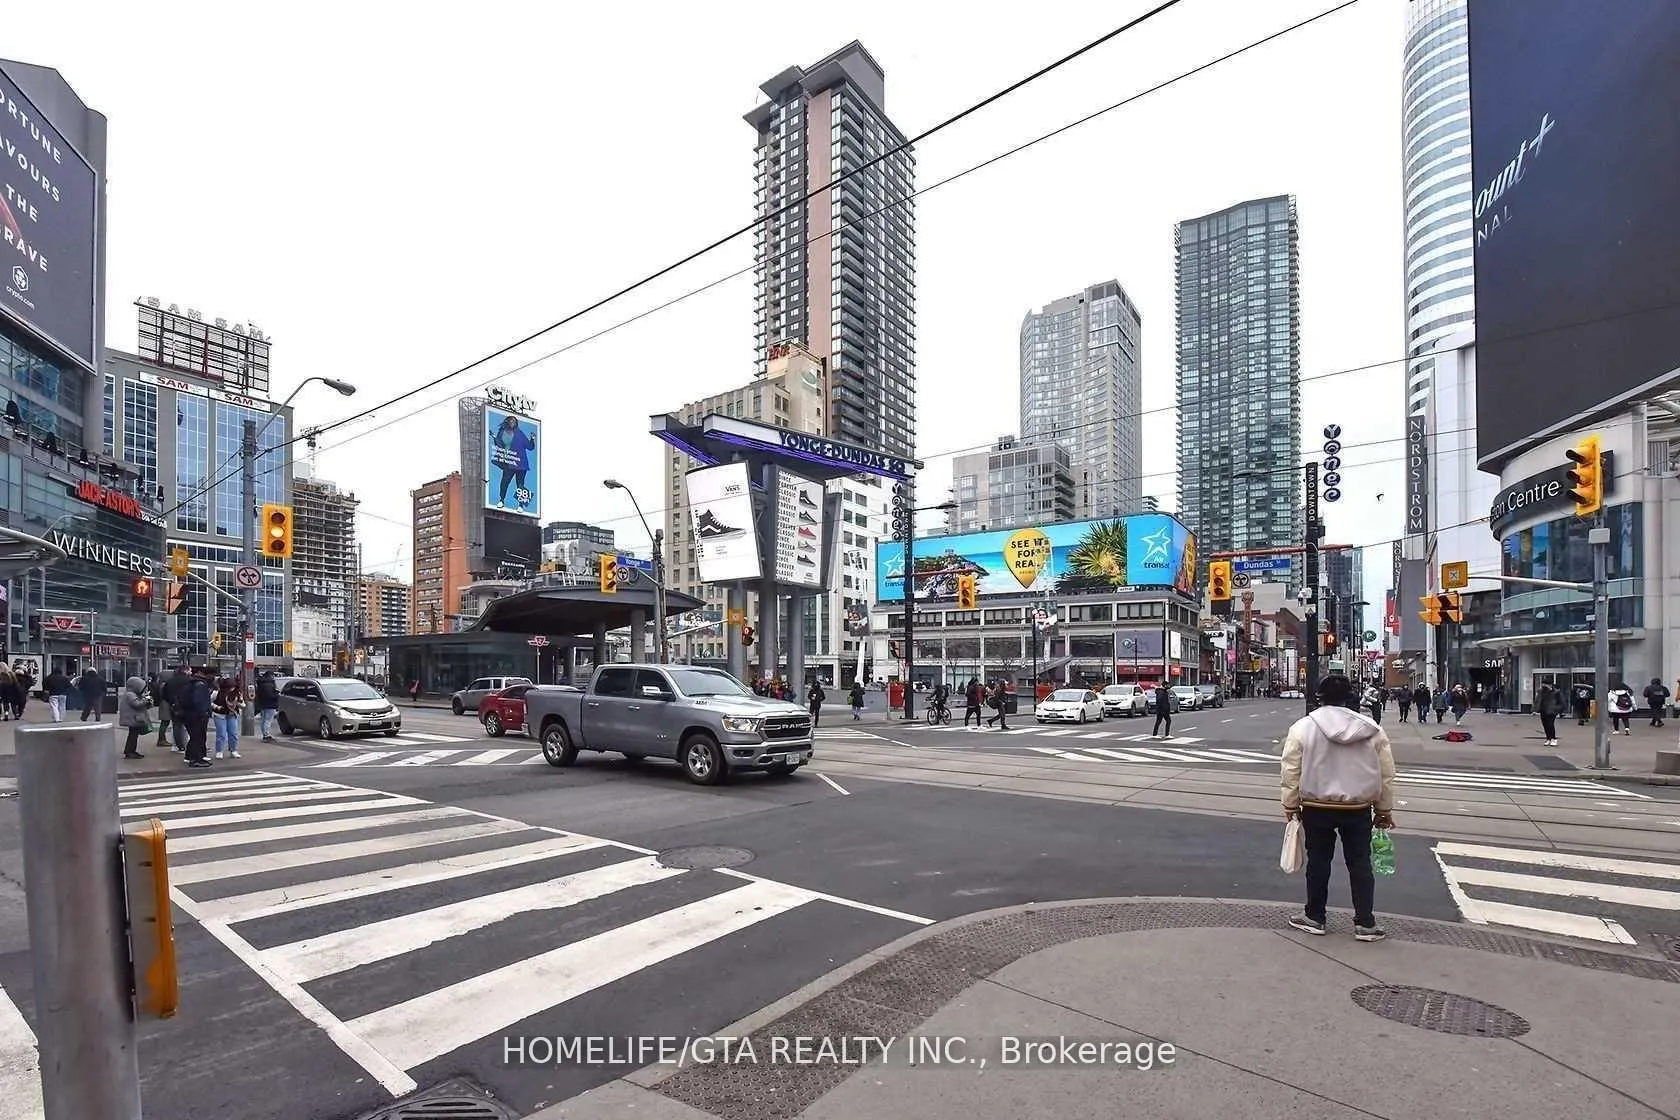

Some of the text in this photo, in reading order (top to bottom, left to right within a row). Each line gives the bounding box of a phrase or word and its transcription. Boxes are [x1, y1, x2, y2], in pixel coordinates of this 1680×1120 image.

[6, 183, 38, 222] THE
[0, 224, 48, 272] RAVE
[156, 376, 189, 391] SAM
[224, 393, 253, 406] SAM
[1308, 467, 1316, 521] DOWNTOWN
[1409, 419, 1424, 530] NORDSTROM
[1508, 481, 1560, 511] Centre
[53, 530, 153, 576] WINNERS
[1011, 540, 1029, 548] SEE
